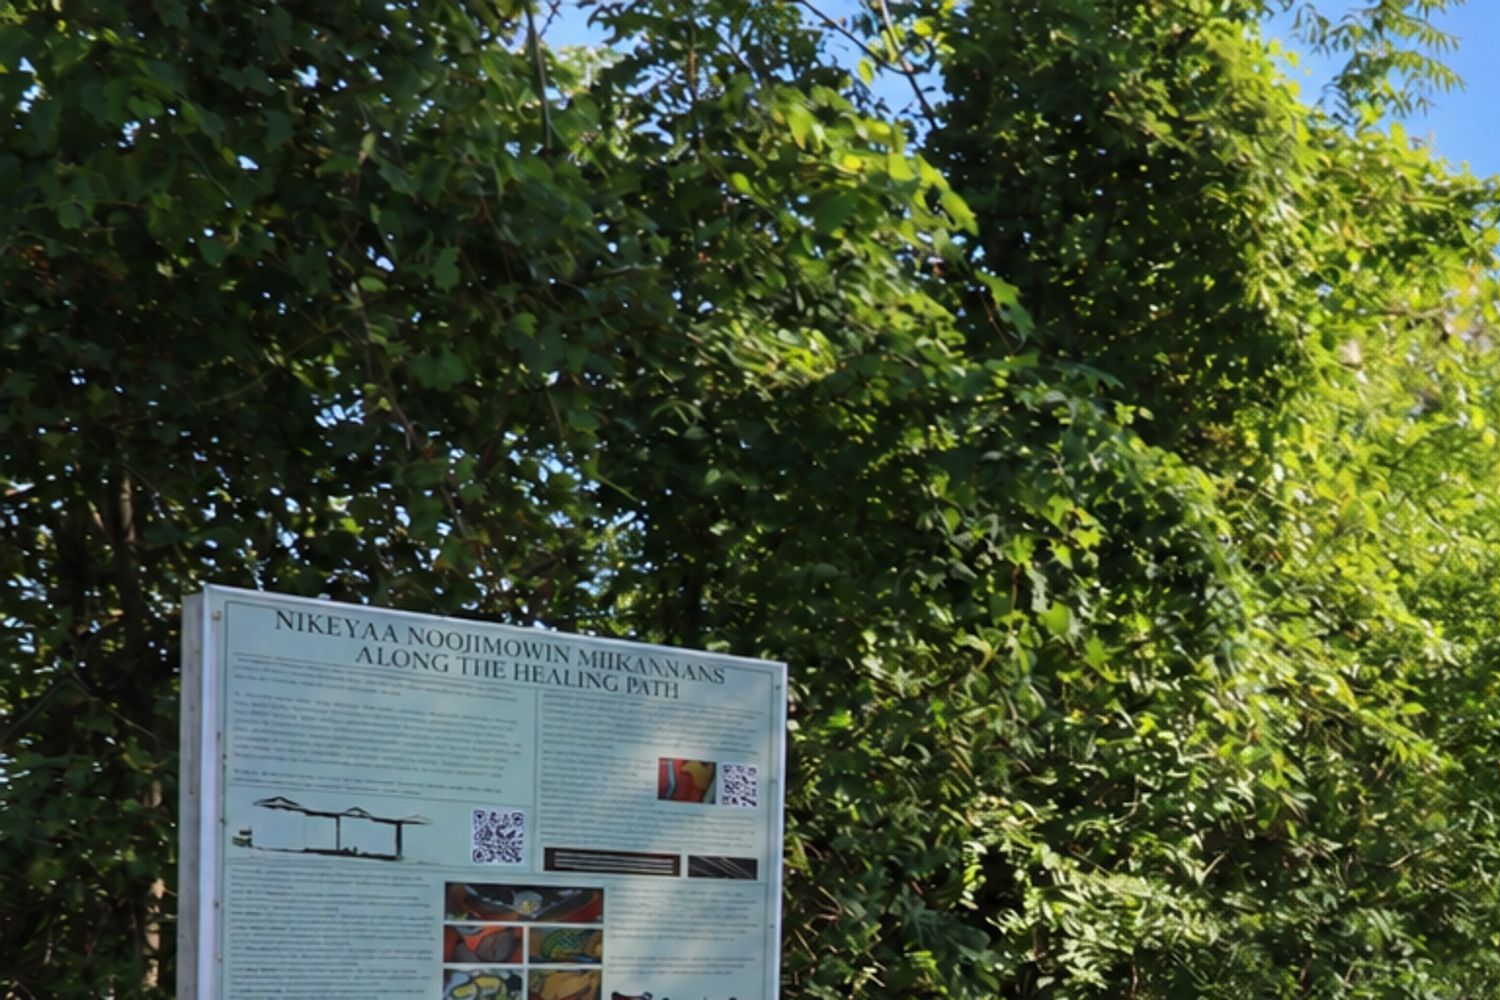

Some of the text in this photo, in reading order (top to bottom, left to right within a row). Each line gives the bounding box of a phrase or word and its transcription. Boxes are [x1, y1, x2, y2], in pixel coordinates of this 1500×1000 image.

[275, 610, 398, 643] NIKEYAA
[407, 626, 569, 664] NOOJIMOWIN
[355, 646, 448, 673] ALONG
[456, 656, 506, 679] THE
[513, 662, 618, 692] HEALING
[626, 676, 679, 699] PATH
